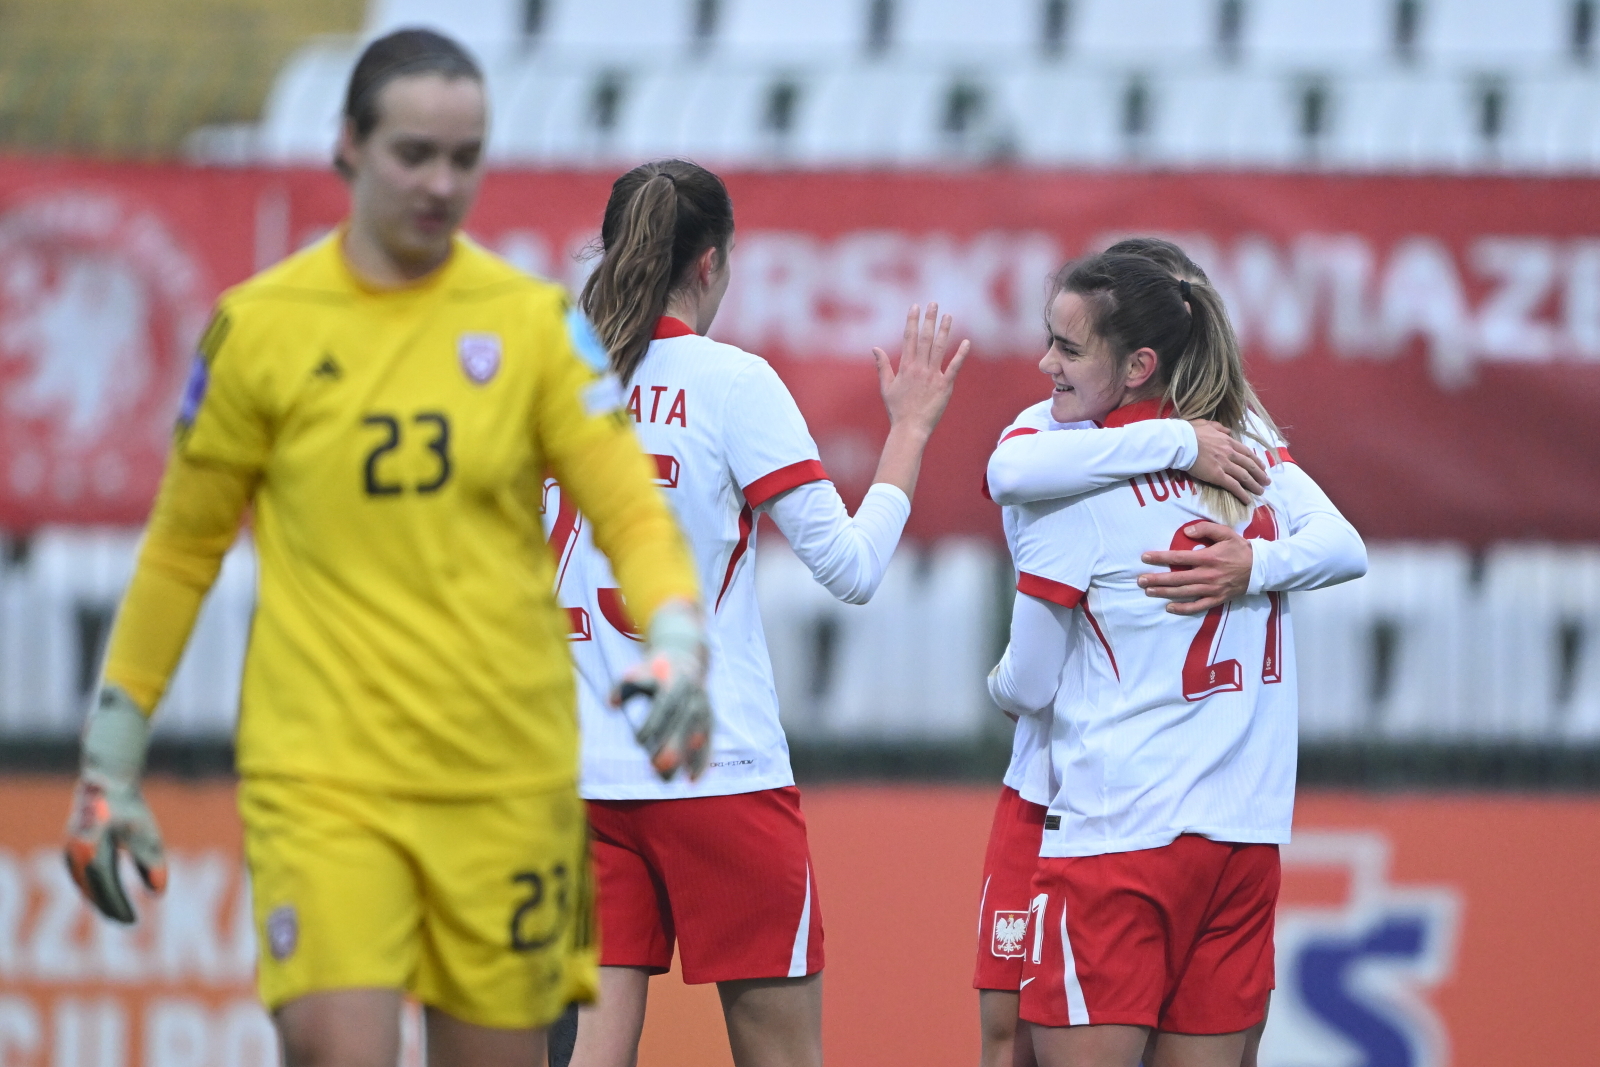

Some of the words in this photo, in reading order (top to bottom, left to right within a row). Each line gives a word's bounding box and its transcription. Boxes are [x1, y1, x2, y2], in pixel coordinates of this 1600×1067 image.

[624, 384, 687, 428] ATA
[361, 411, 452, 495] 23
[1169, 503, 1282, 702] 21
[1025, 893, 1049, 965] 1
